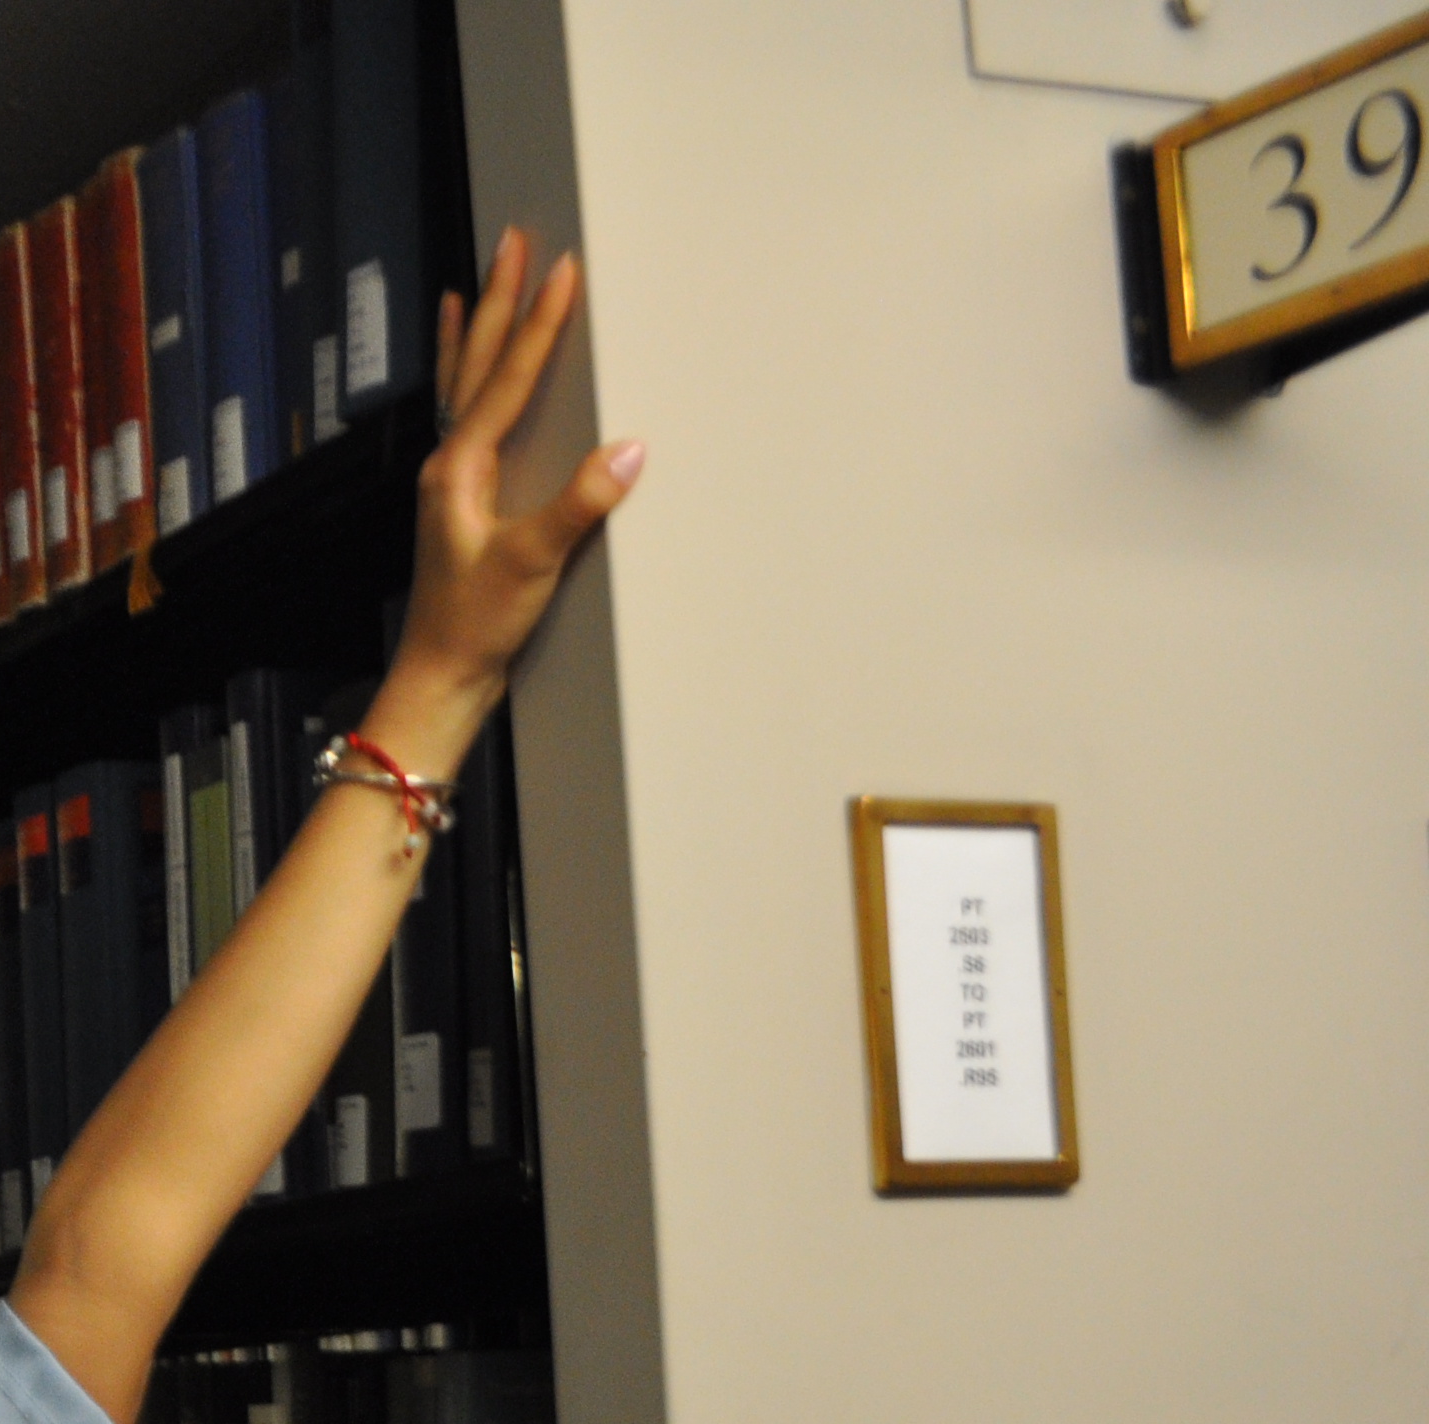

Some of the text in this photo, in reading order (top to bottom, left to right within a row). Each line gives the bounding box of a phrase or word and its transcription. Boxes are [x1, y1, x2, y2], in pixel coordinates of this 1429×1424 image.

[1248, 87, 1423, 282] 39
[960, 896, 985, 916] PT
[962, 1010, 987, 1030] PT
